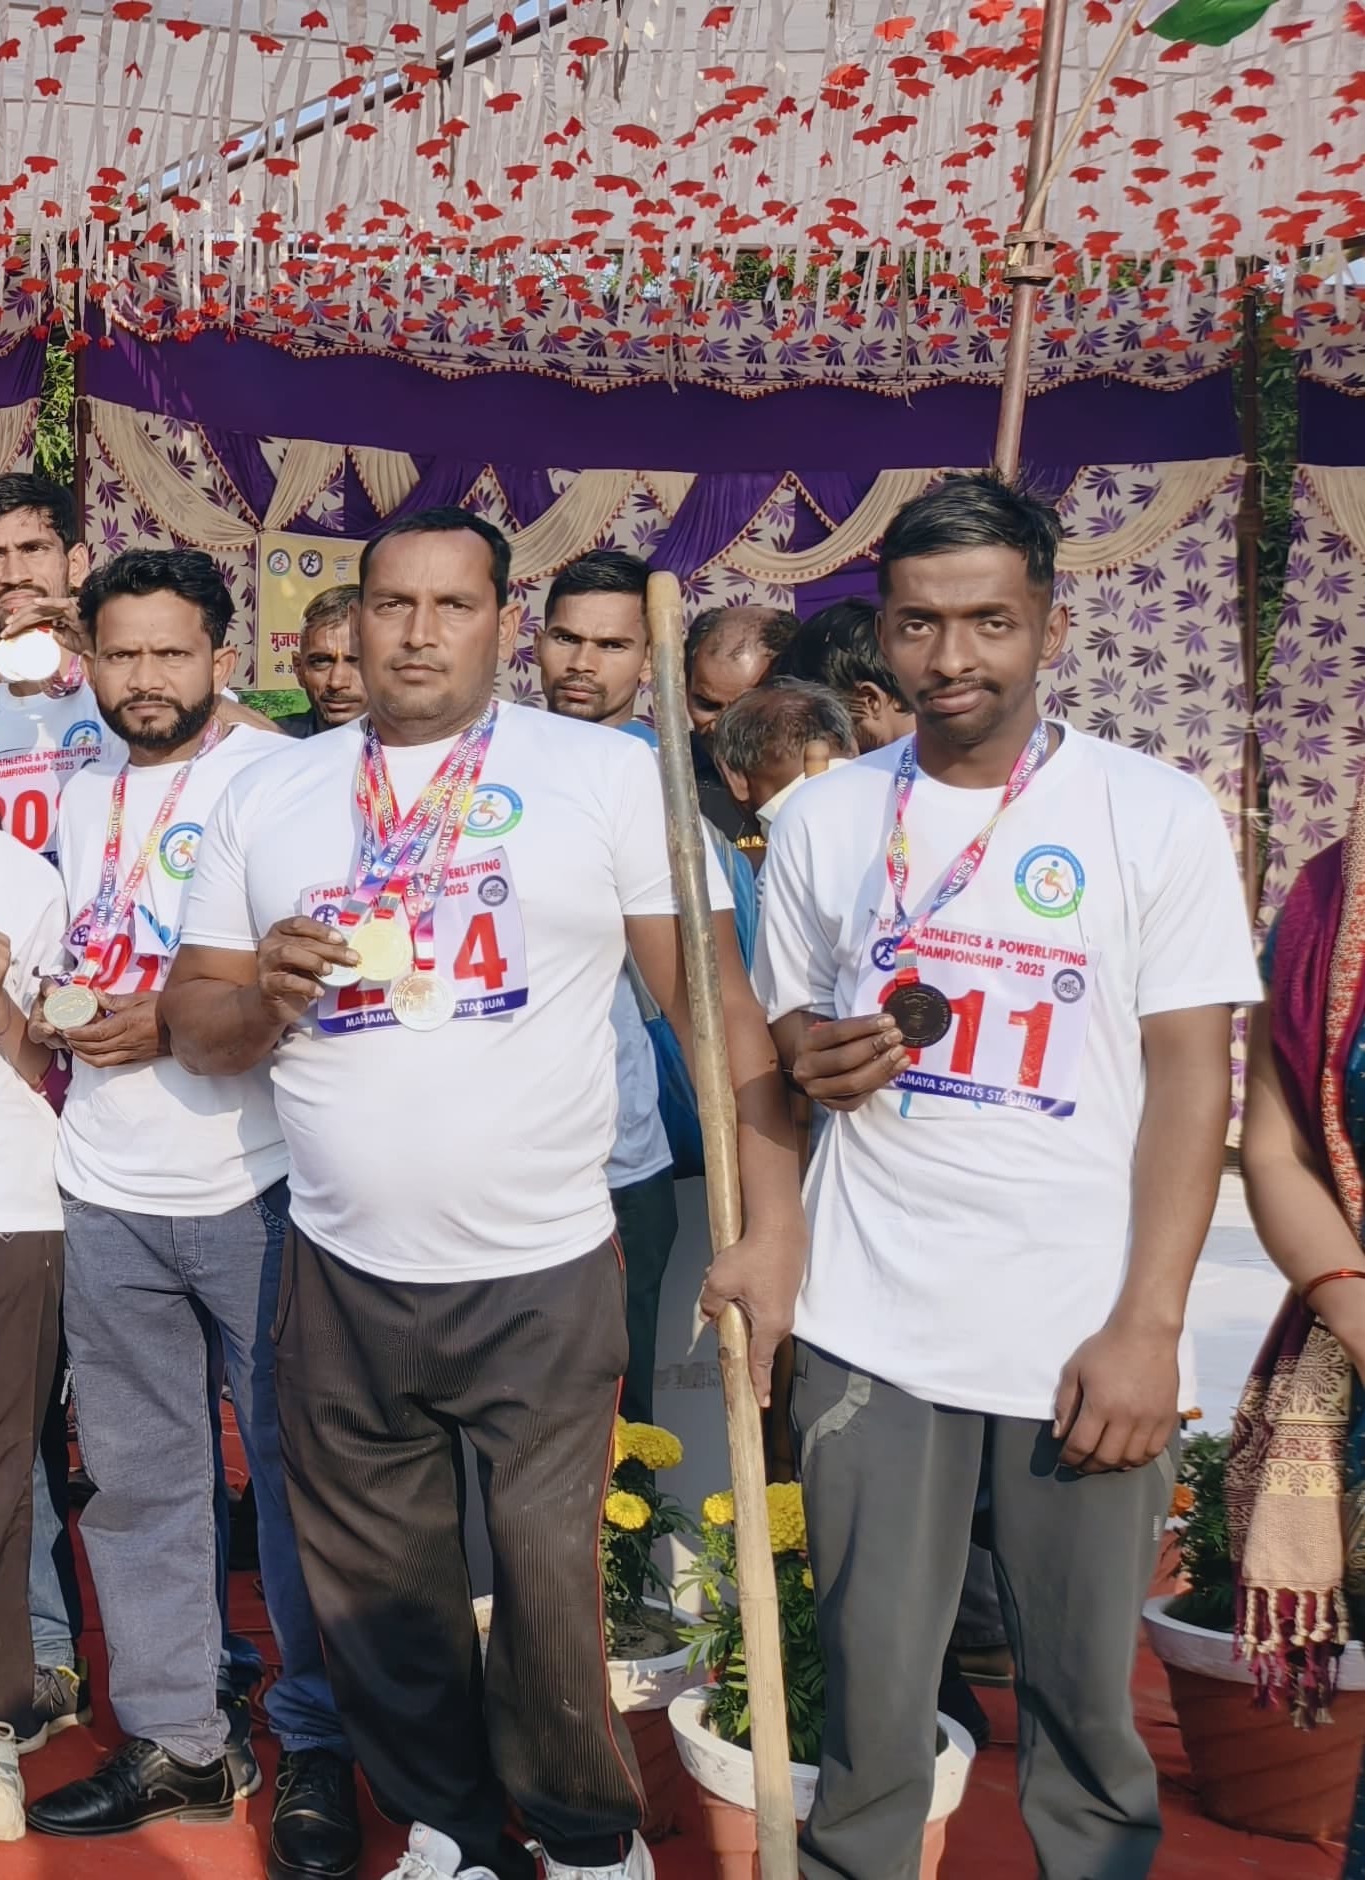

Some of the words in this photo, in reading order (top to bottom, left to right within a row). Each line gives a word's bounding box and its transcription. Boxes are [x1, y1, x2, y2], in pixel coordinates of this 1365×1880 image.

[43, 746, 102, 760] POWERLIFTING
[56, 761, 74, 772] 2025
[384, 838, 404, 864] PARA
[402, 797, 433, 844] ATHLETICS
[438, 730, 483, 788] POWERLIFTING
[407, 842, 425, 866] PARA
[422, 801, 446, 845] ATHLETICS
[428, 862, 444, 893] PARA
[437, 803, 462, 862] ATHLETICS
[101, 854, 116, 904] ATHLETICS
[323, 884, 352, 900] PARA
[447, 858, 501, 879] ERLIFTING
[443, 882, 470, 897] 2025
[96, 903, 110, 929] PARA
[111, 899, 127, 924] PARA
[916, 945, 1003, 969] HAMPIONSHIP
[1015, 962, 1045, 977] 2025
[920, 928, 983, 948] ATHLETICS
[985, 938, 994, 949] &
[998, 939, 1087, 967] POWERLIFTING
[346, 1012, 394, 1028] MAHAMA
[456, 997, 506, 1014] STADIUM
[939, 1080, 983, 1099] SPORTS
[986, 1089, 1043, 1111] STADIUM
